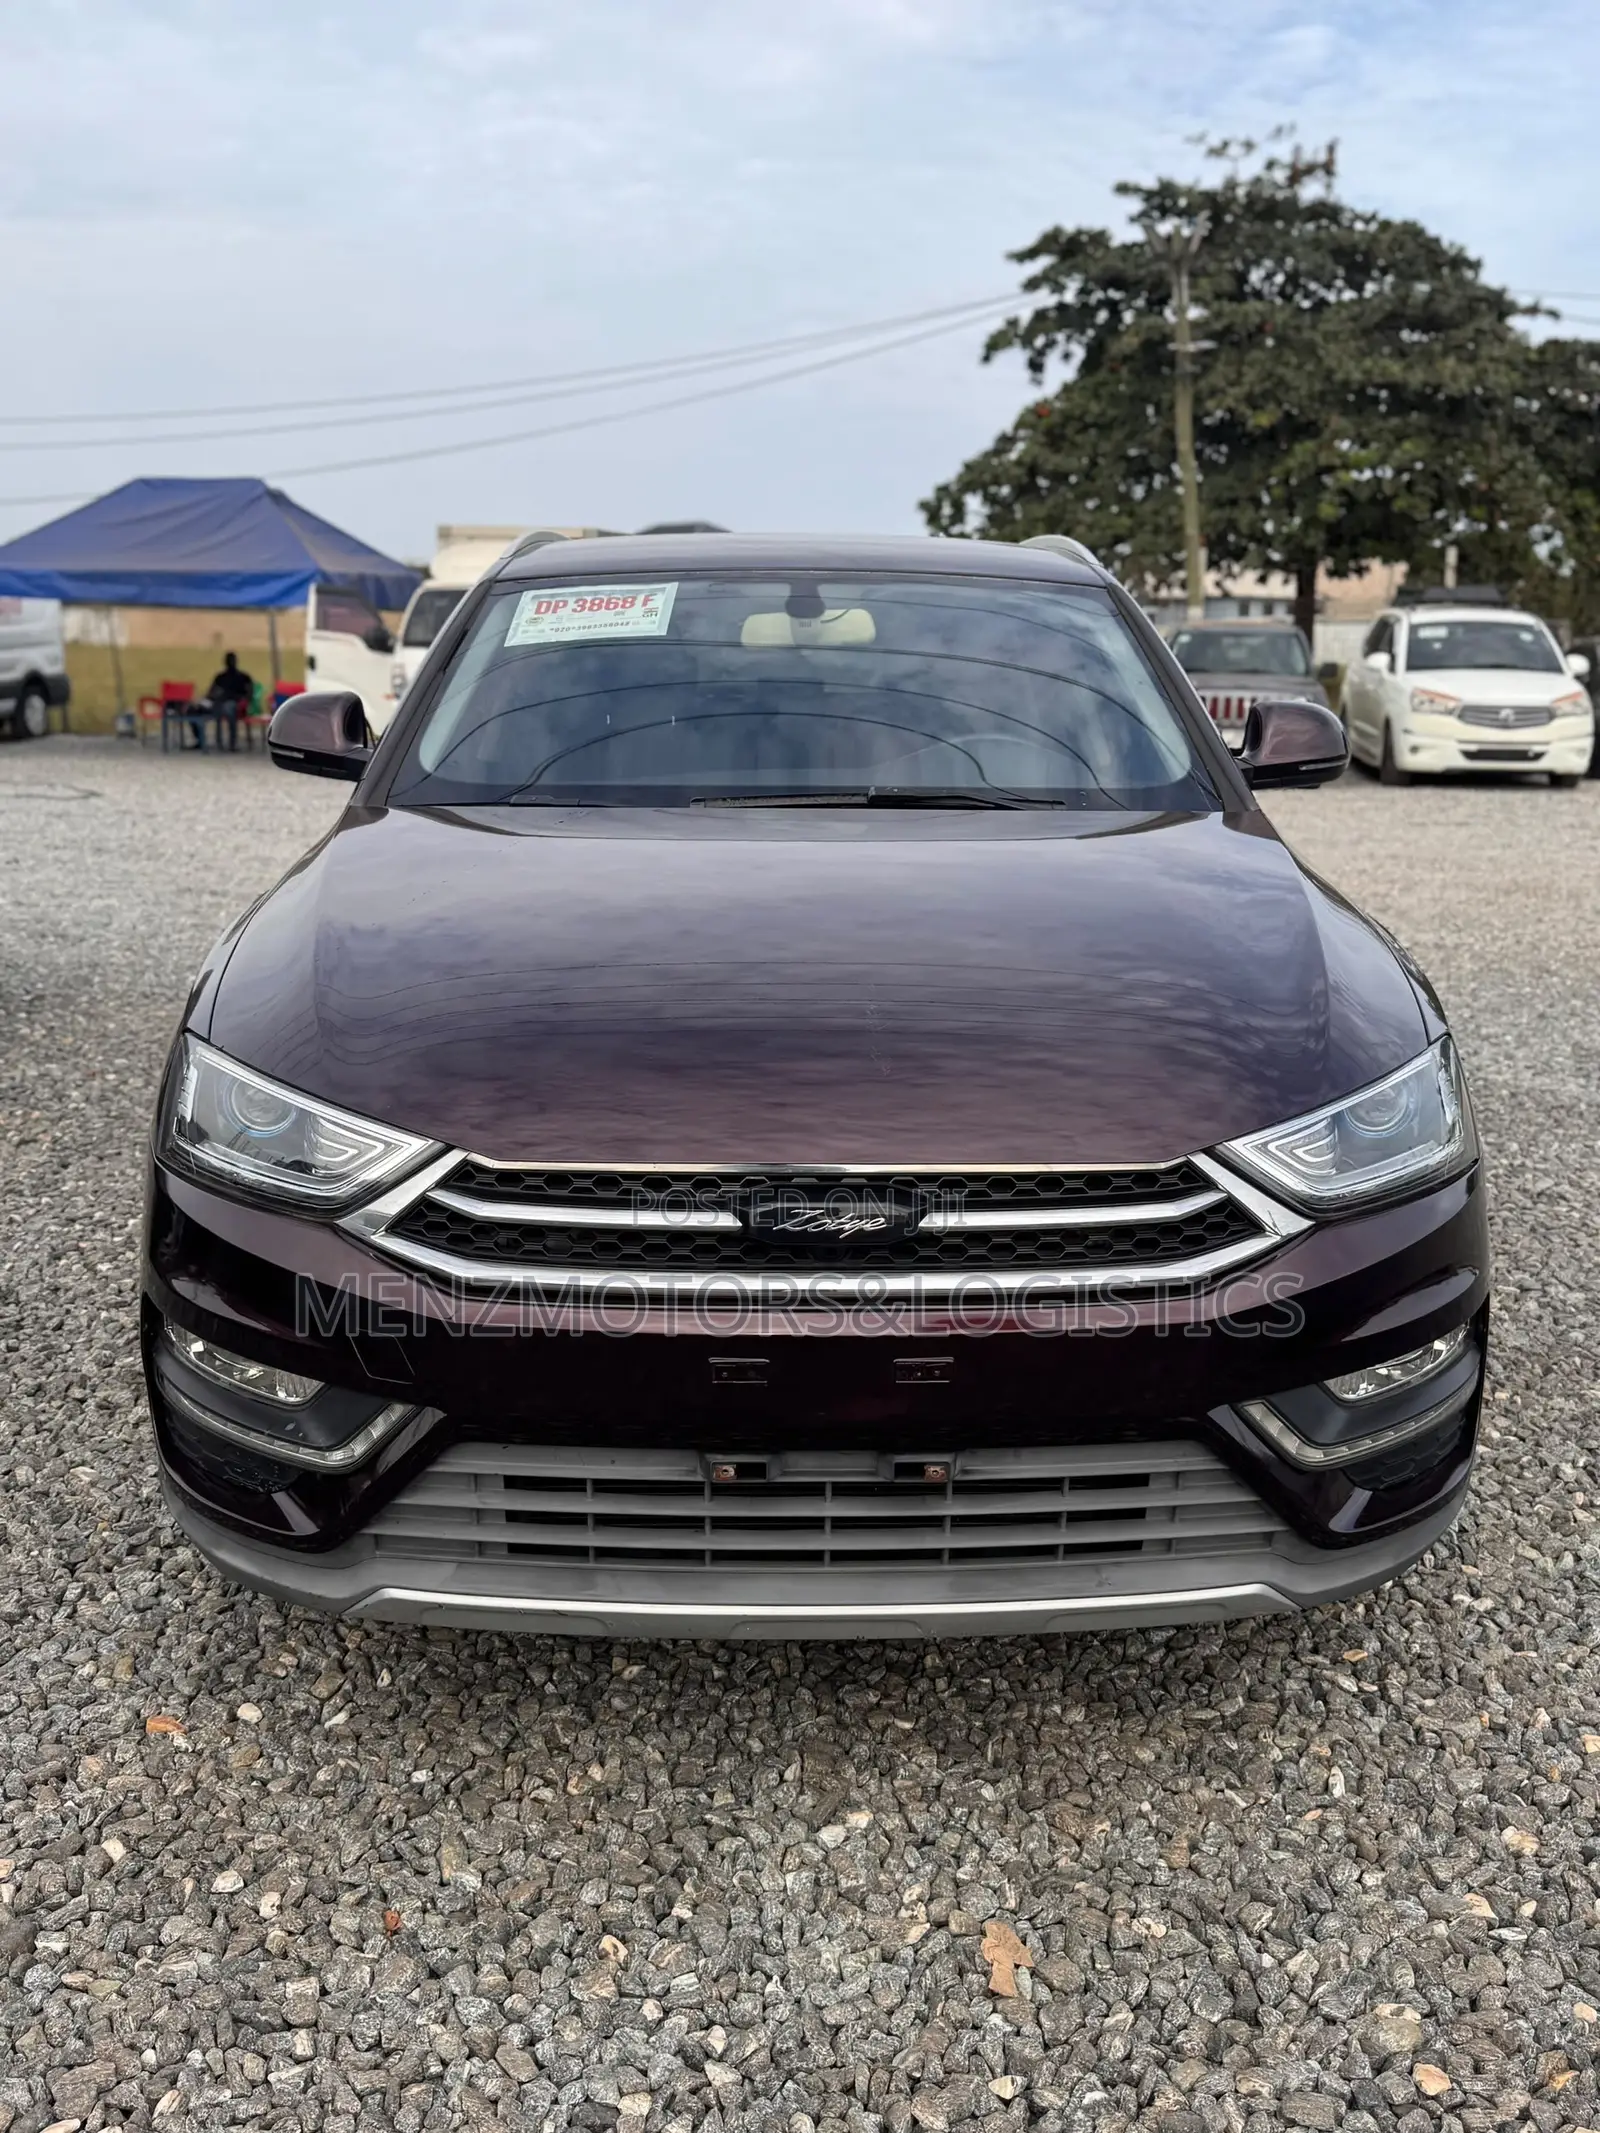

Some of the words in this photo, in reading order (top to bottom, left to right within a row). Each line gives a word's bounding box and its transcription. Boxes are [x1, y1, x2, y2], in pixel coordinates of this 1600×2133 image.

[535, 599, 568, 615] DP
[572, 595, 637, 613] 3868
[642, 592, 657, 608] F
[773, 1209, 887, 1238] Zotye
